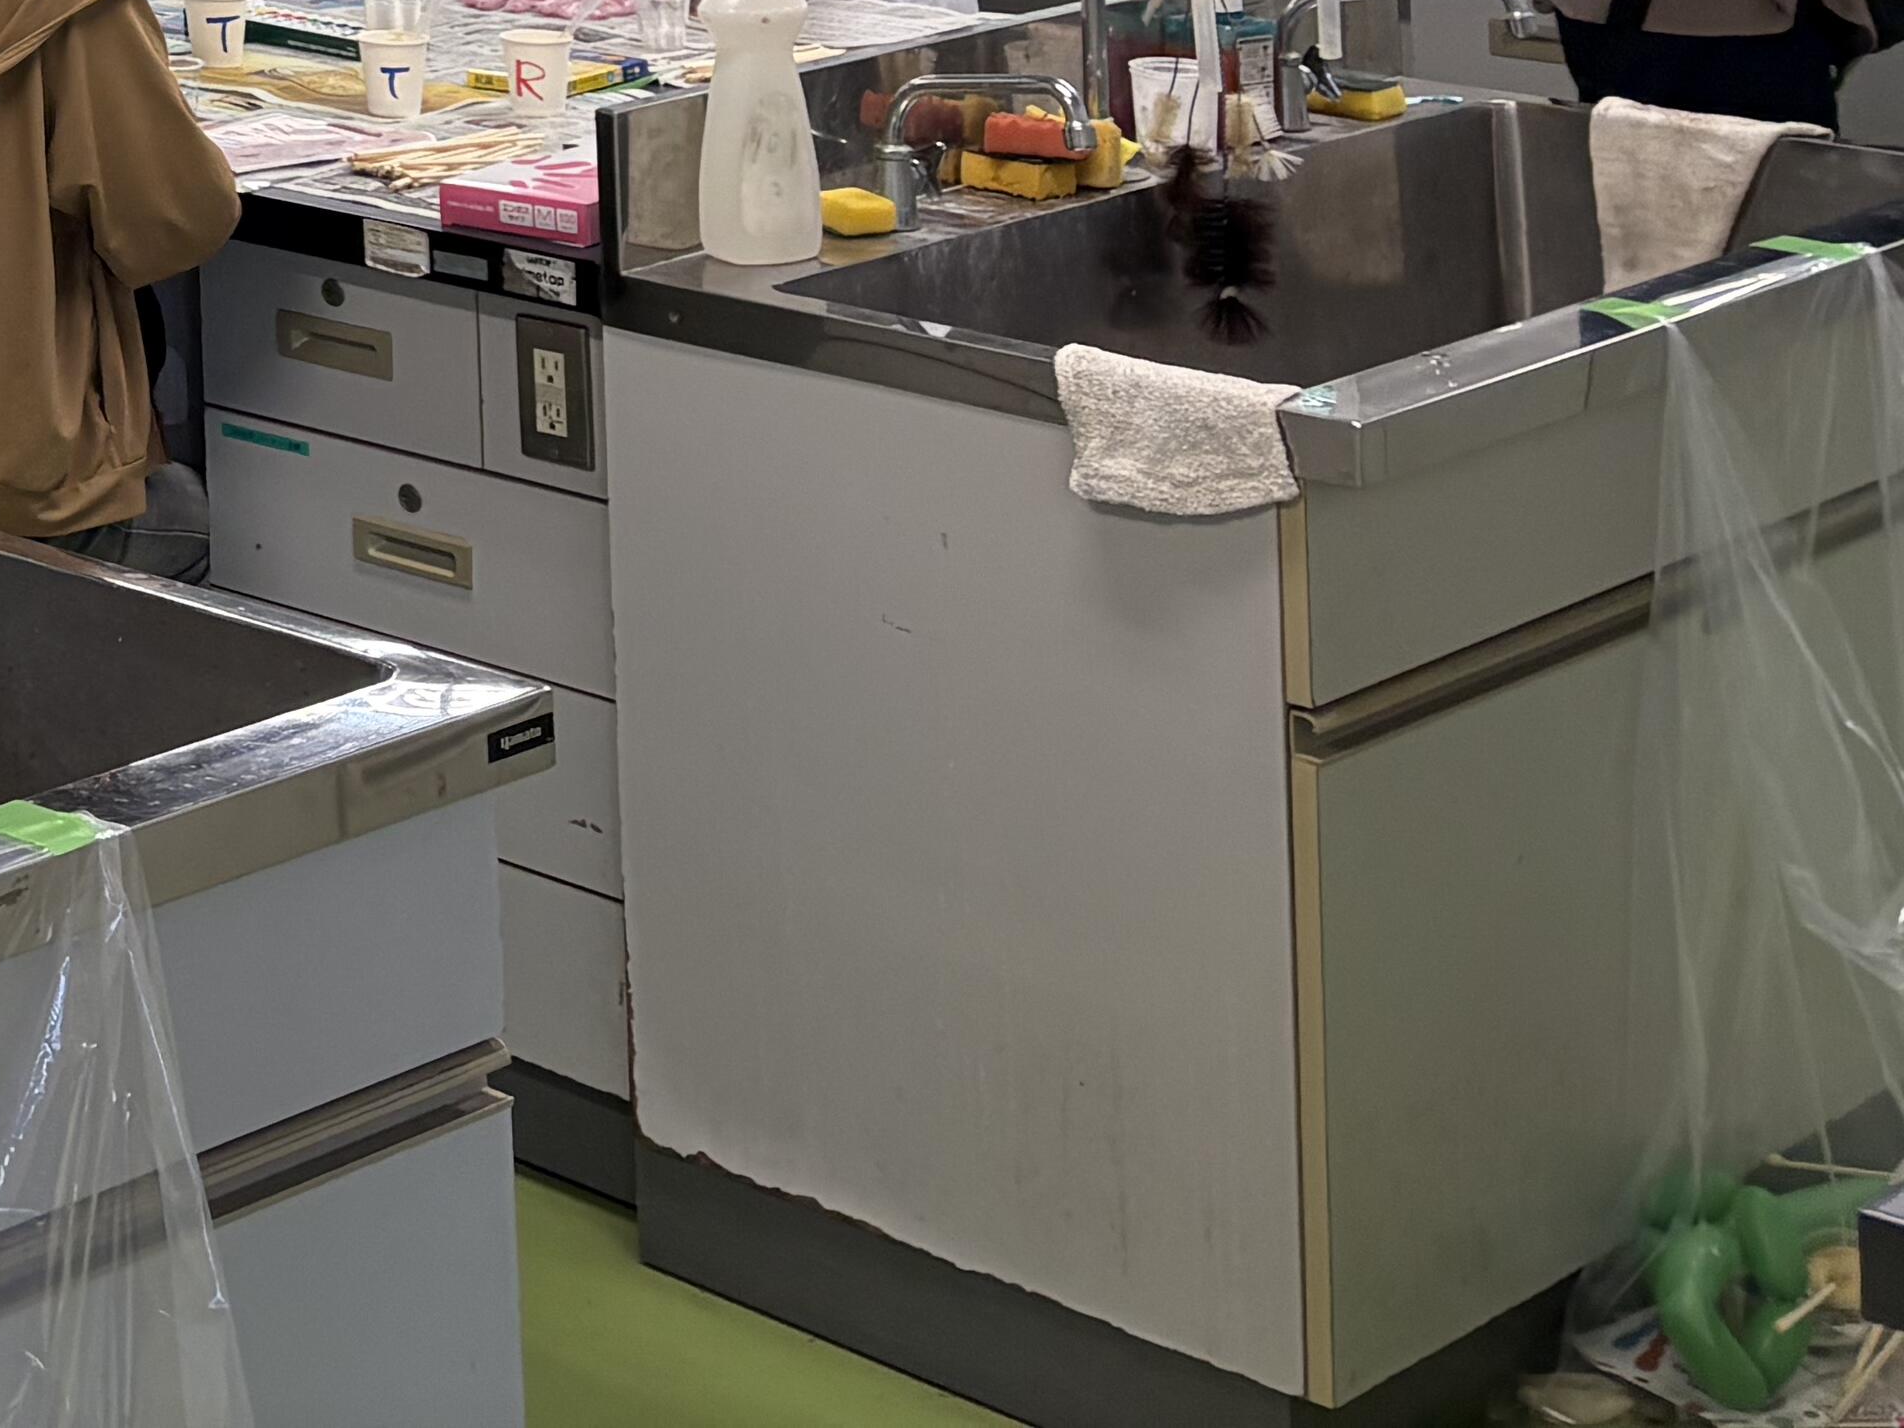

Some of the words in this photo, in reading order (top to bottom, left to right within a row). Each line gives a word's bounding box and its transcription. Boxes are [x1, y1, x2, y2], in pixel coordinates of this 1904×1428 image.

[205, 15, 240, 53] T
[379, 66, 411, 99] T
[515, 59, 546, 101] R
[537, 207, 553, 221] M
